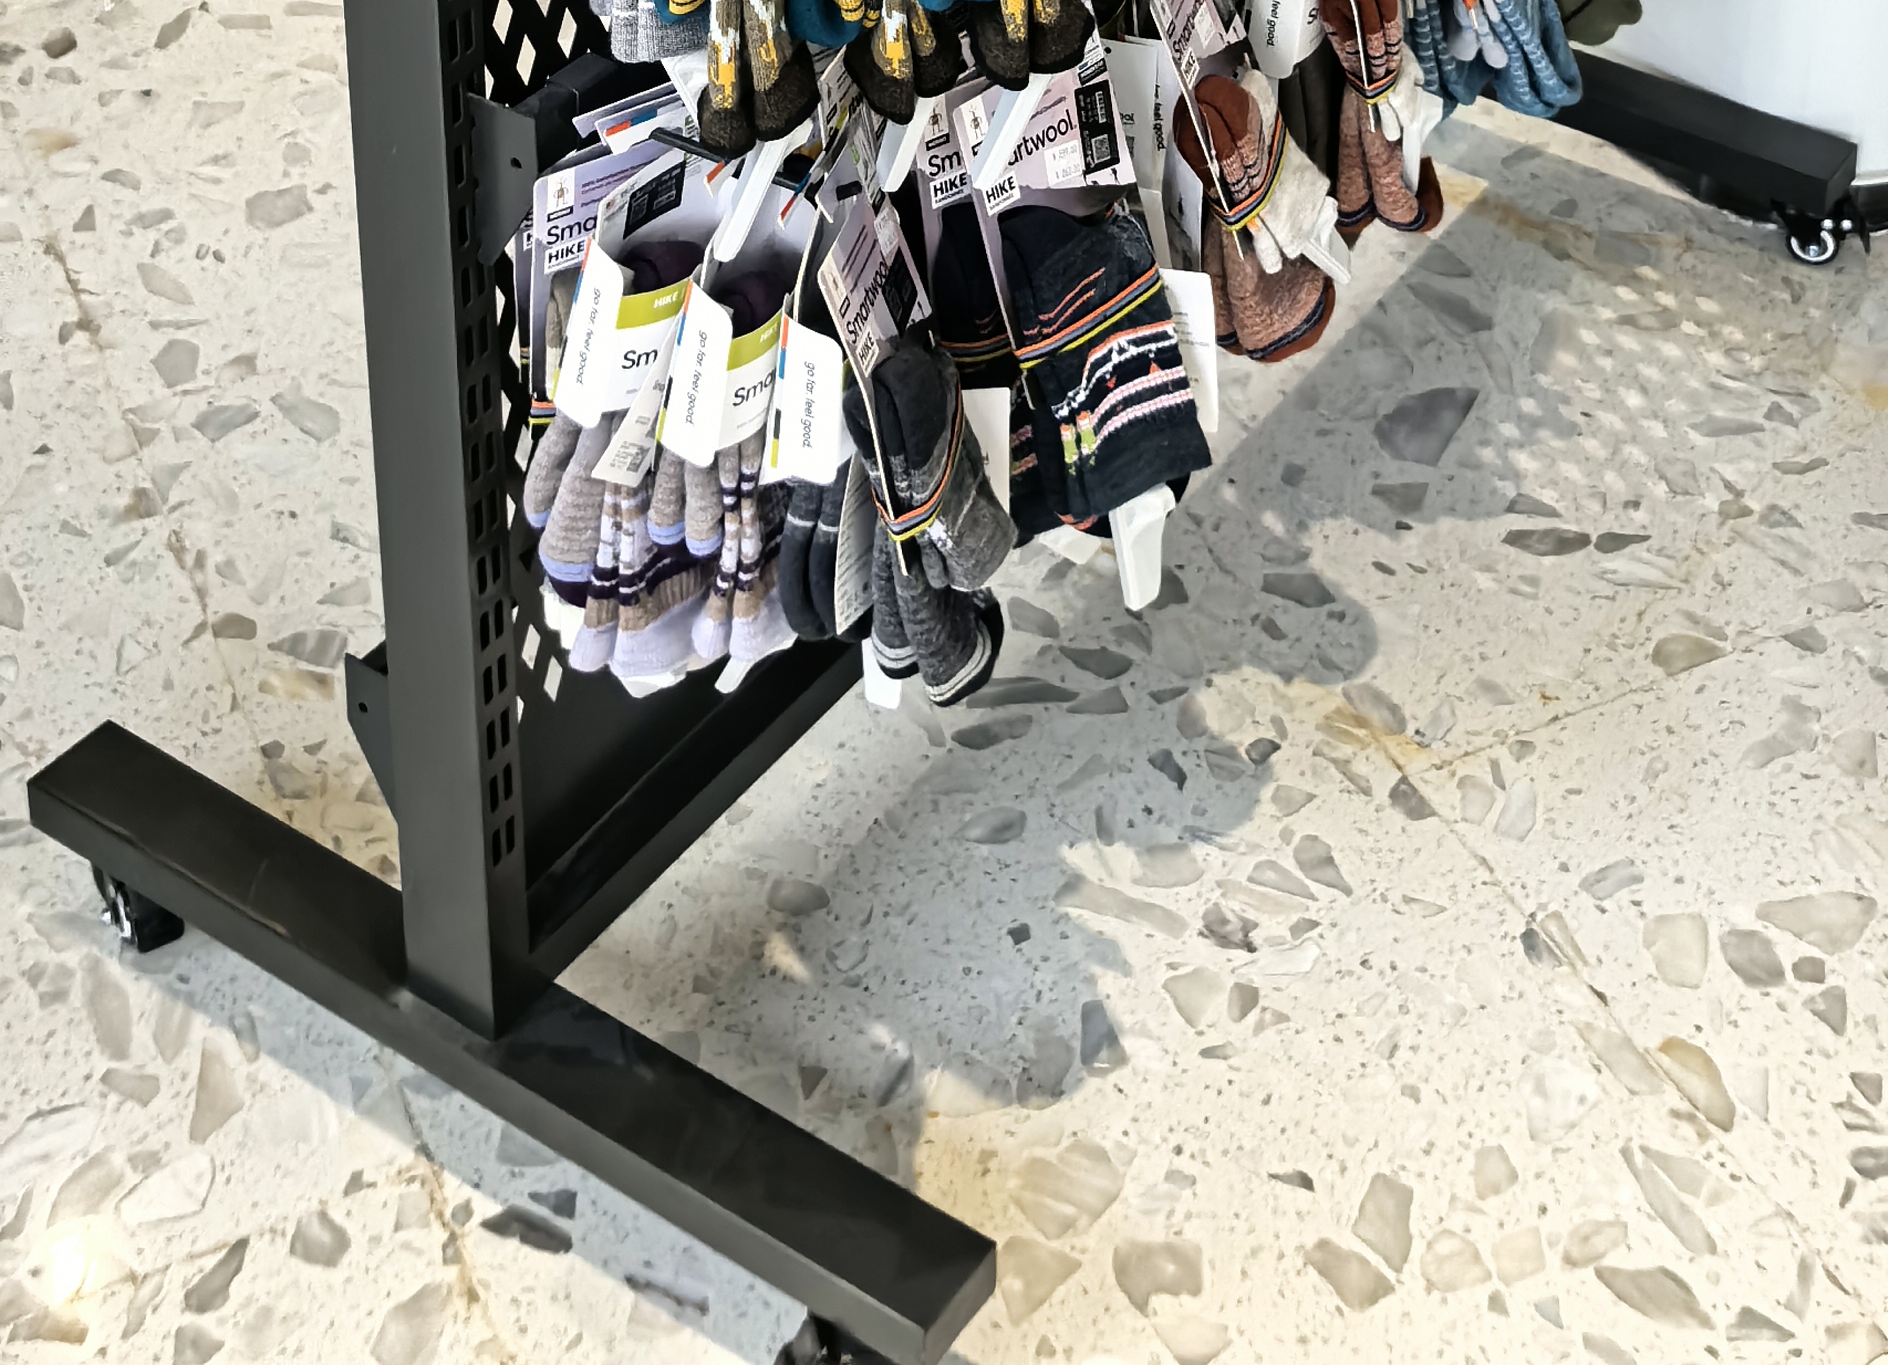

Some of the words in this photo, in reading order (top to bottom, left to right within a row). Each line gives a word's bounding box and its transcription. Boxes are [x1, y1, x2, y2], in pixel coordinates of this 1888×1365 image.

[1266, 20, 1277, 49] good.
[928, 150, 962, 178] Sm
[933, 171, 968, 198] HIKE
[985, 175, 1016, 204] HIKE
[548, 239, 586, 264] HIKE
[592, 287, 601, 306] go
[653, 290, 679, 309] HIKE
[698, 329, 707, 349] go
[804, 360, 815, 378] go
